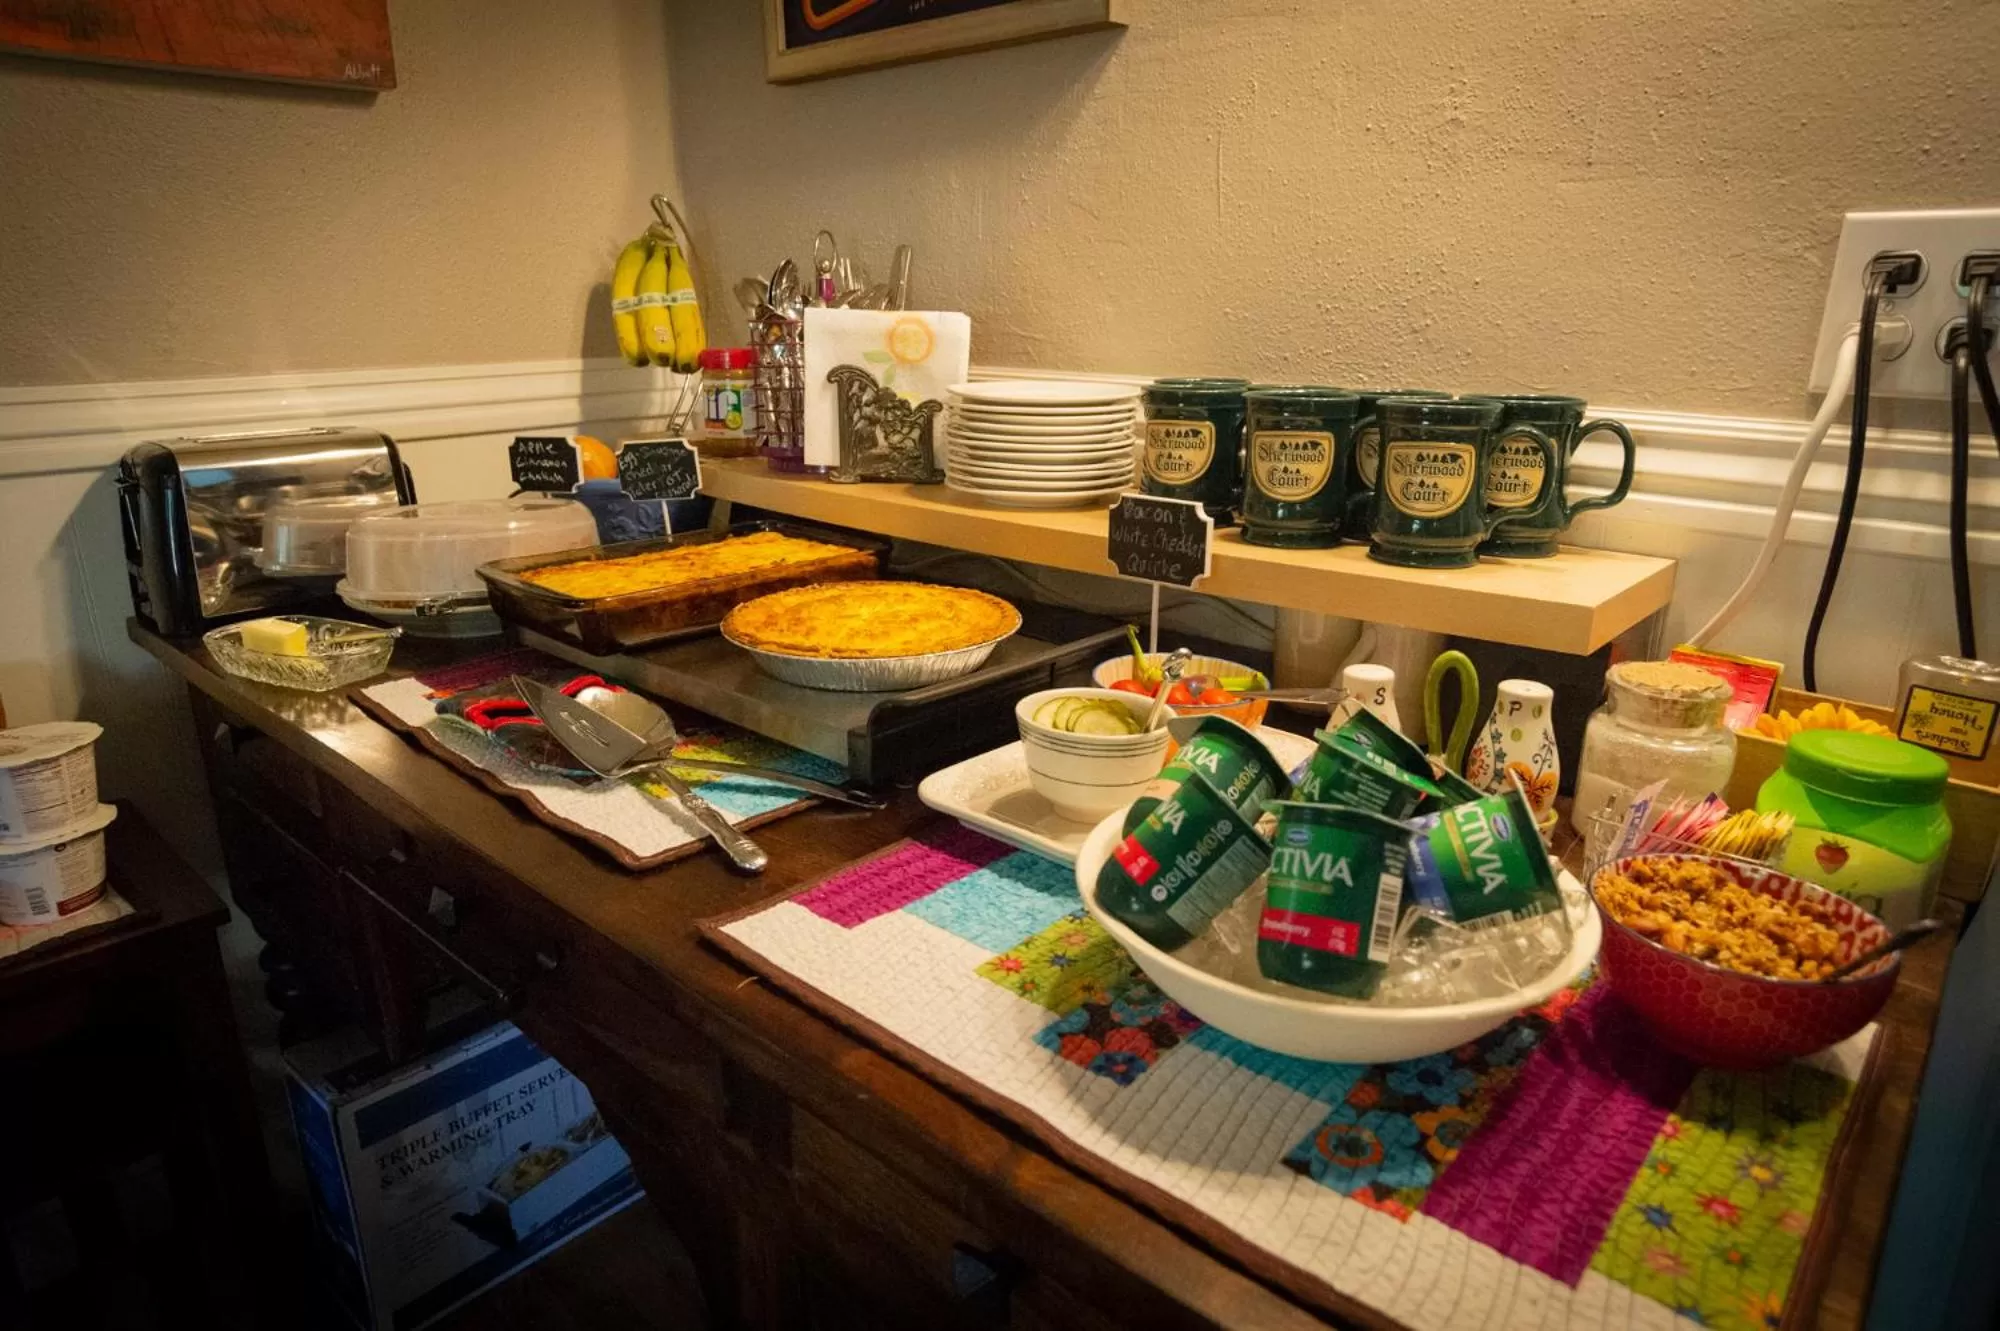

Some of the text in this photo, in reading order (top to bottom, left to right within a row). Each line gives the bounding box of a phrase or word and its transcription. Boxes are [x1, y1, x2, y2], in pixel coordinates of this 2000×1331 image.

[1150, 429, 1207, 451] Sherwood
[1155, 451, 1194, 472] Court
[1258, 441, 1326, 464] Sherwood
[1490, 455, 1545, 470] erwood
[1391, 453, 1465, 477] Sherwood
[1267, 467, 1311, 487] Court
[1402, 479, 1452, 502] Court
[1374, 687, 1386, 705] S
[1508, 701, 1523, 717] P
[1271, 847, 1354, 888] CTIVIA
[377, 1067, 568, 1170] TRIPLE BUFFET SERVE
[399, 1125, 492, 1178] WARMING
[494, 1099, 538, 1131] TRAY
